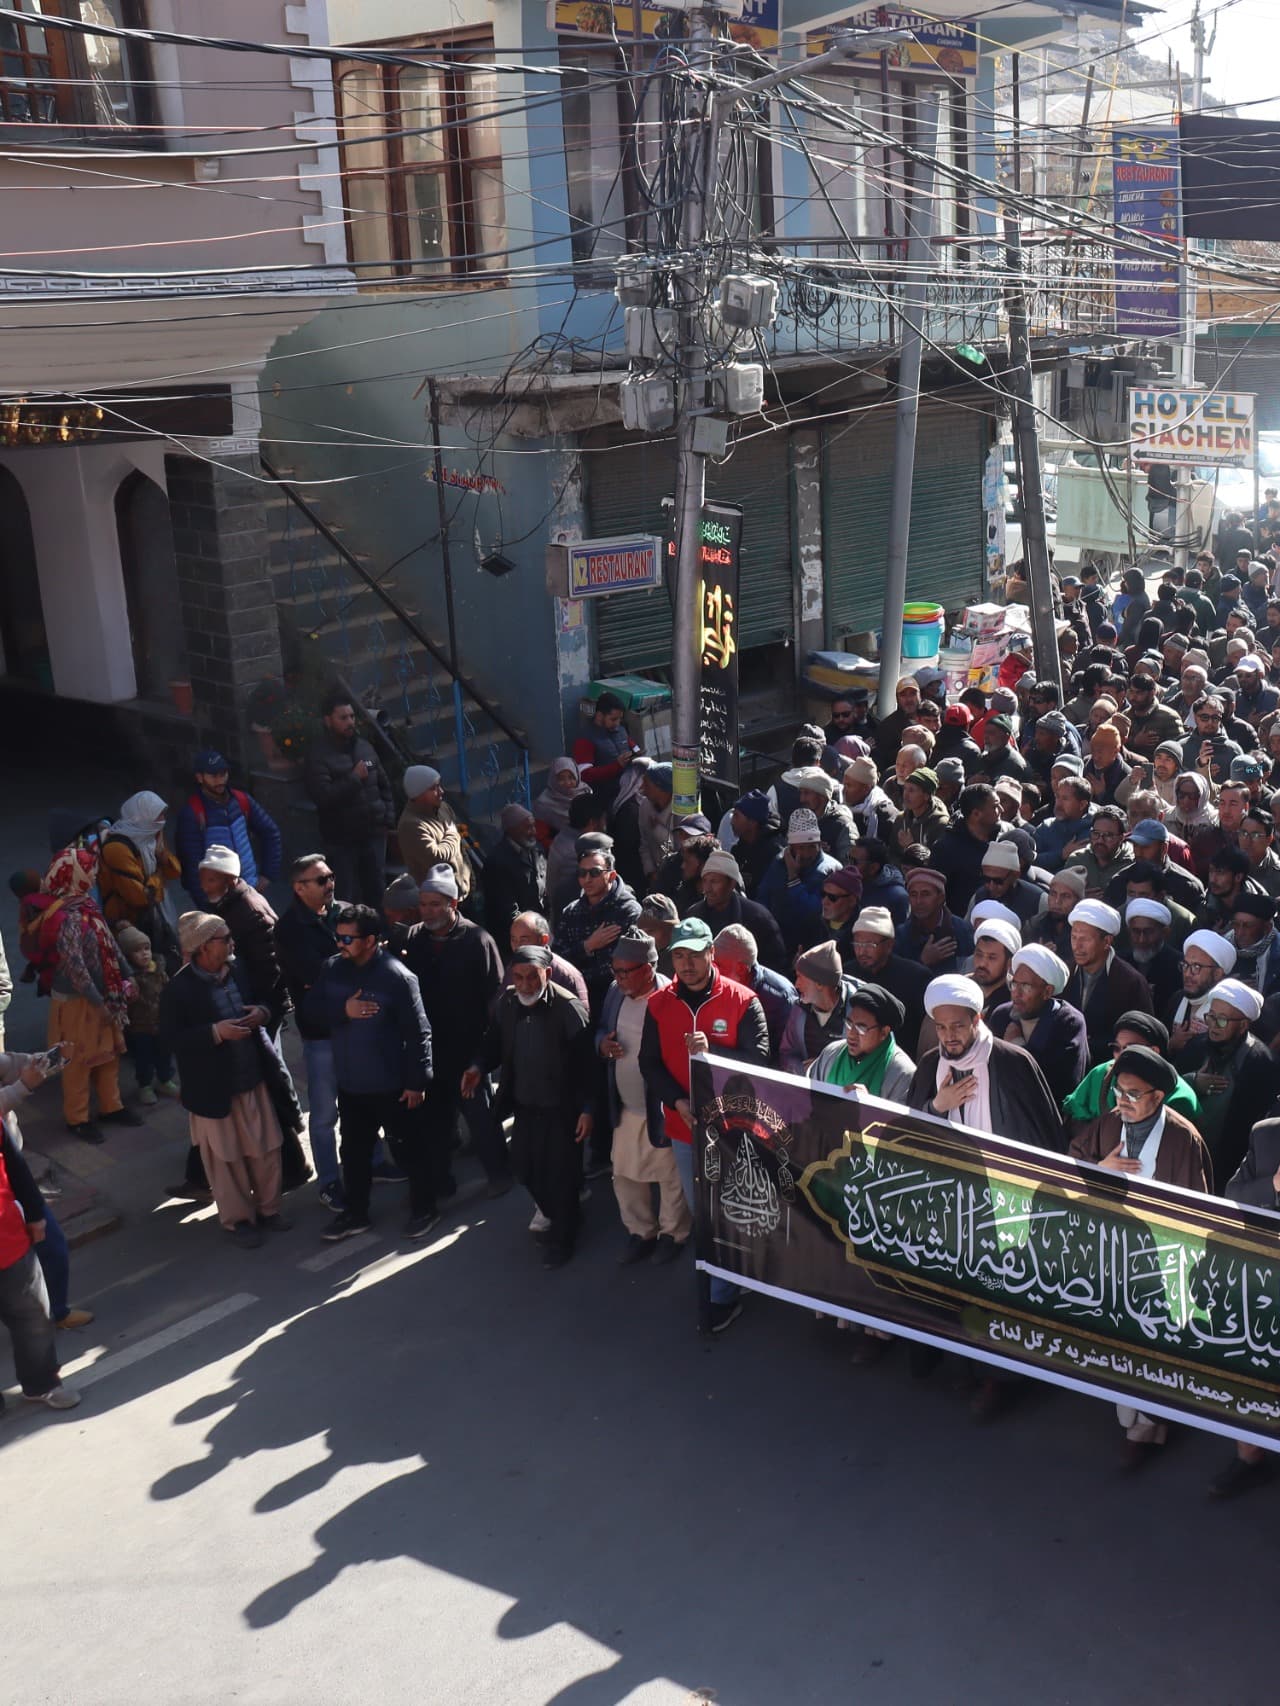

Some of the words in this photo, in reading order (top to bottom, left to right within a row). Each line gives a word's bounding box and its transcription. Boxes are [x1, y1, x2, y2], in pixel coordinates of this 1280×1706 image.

[853, 9, 968, 38] RETAURANT
[1115, 165, 1175, 182] RESTAURANT
[1134, 391, 1249, 423] HOTEL
[1130, 422, 1252, 451] SIACHEN
[589, 548, 654, 585] RESTAURANT
